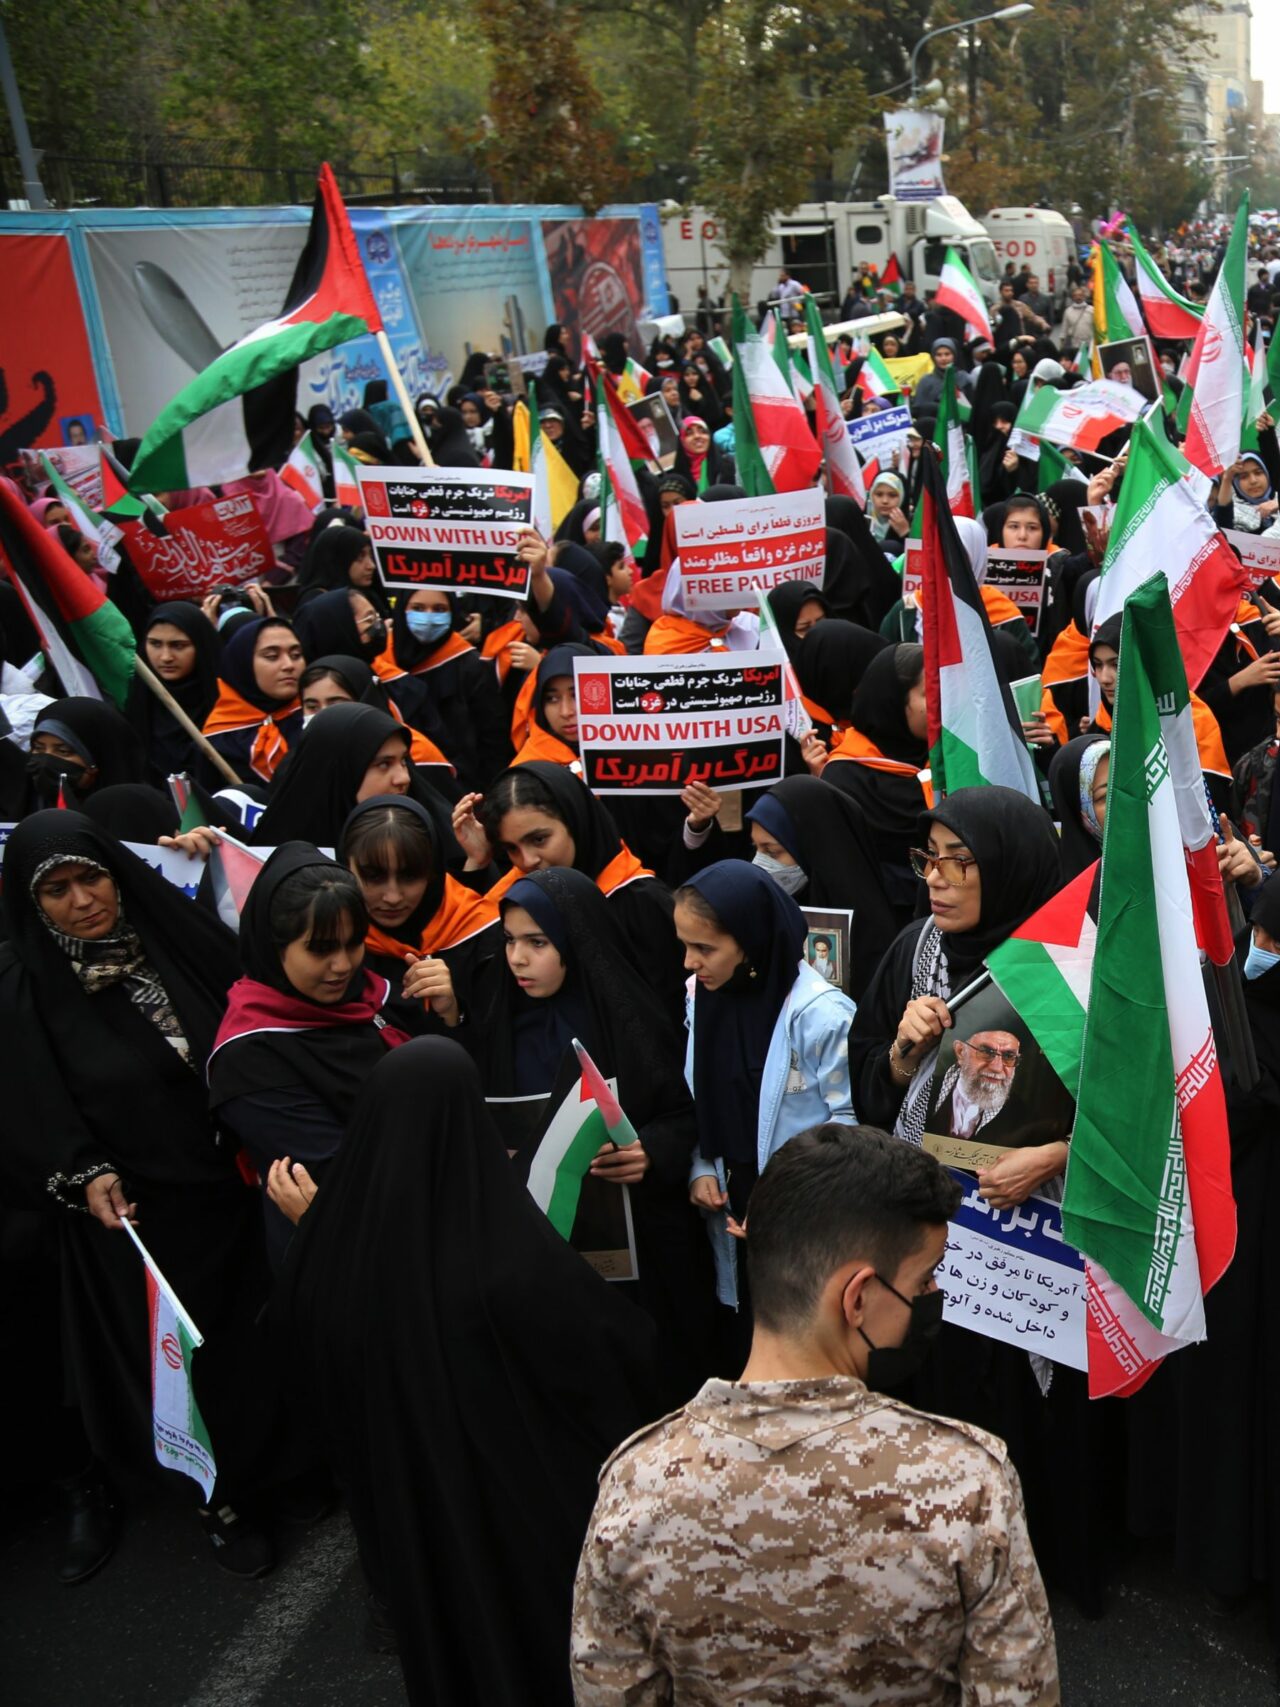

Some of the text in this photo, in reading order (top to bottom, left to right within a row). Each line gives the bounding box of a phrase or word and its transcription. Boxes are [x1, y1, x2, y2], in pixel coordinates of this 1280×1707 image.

[388, 484, 418, 498] جنایات
[418, 485, 444, 499] قطعی
[445, 487, 464, 500] جرم
[466, 486, 494, 500] شریک
[392, 503, 411, 513] است
[411, 503, 428, 518] غزه
[430, 505, 440, 517] در
[495, 506, 525, 520] رژیم
[793, 513, 822, 528] پیروزی
[371, 524, 432, 543] DOWN
[434, 528, 486, 545] WITH
[681, 528, 704, 539] است
[706, 523, 744, 540] فلسطین
[747, 522, 769, 535] برای
[775, 541, 796, 562] غزه
[799, 540, 824, 557] مردم
[683, 552, 739, 571] مظلومند
[386, 553, 528, 586] مرگ بر آمریکا
[686, 561, 823, 595] FREE PALESTINE
[1008, 591, 1039, 602] USA
[614, 676, 651, 688] جنایات
[653, 675, 685, 690] قطعی
[687, 677, 710, 689] جرم
[712, 673, 743, 687] شریک
[616, 690, 776, 711] رژیم صهیونیستی در غزه است
[581, 714, 782, 742] DOWN WITH USA
[595, 750, 778, 787] مرگ بر آمریکا
[943, 1241, 963, 1251] خو
[966, 1248, 983, 1260] در
[949, 1265, 963, 1279] ها
[1024, 1268, 1032, 1281] تا
[966, 1274, 987, 1290] زن
[1037, 1273, 1080, 1296] آمریکا
[991, 1284, 999, 1295] و
[1002, 1288, 1059, 1313] کودکان
[972, 1304, 980, 1315] و
[984, 1307, 1013, 1324] شده
[1060, 1308, 1069, 1321] و
[1016, 1319, 1056, 1339] داخل
